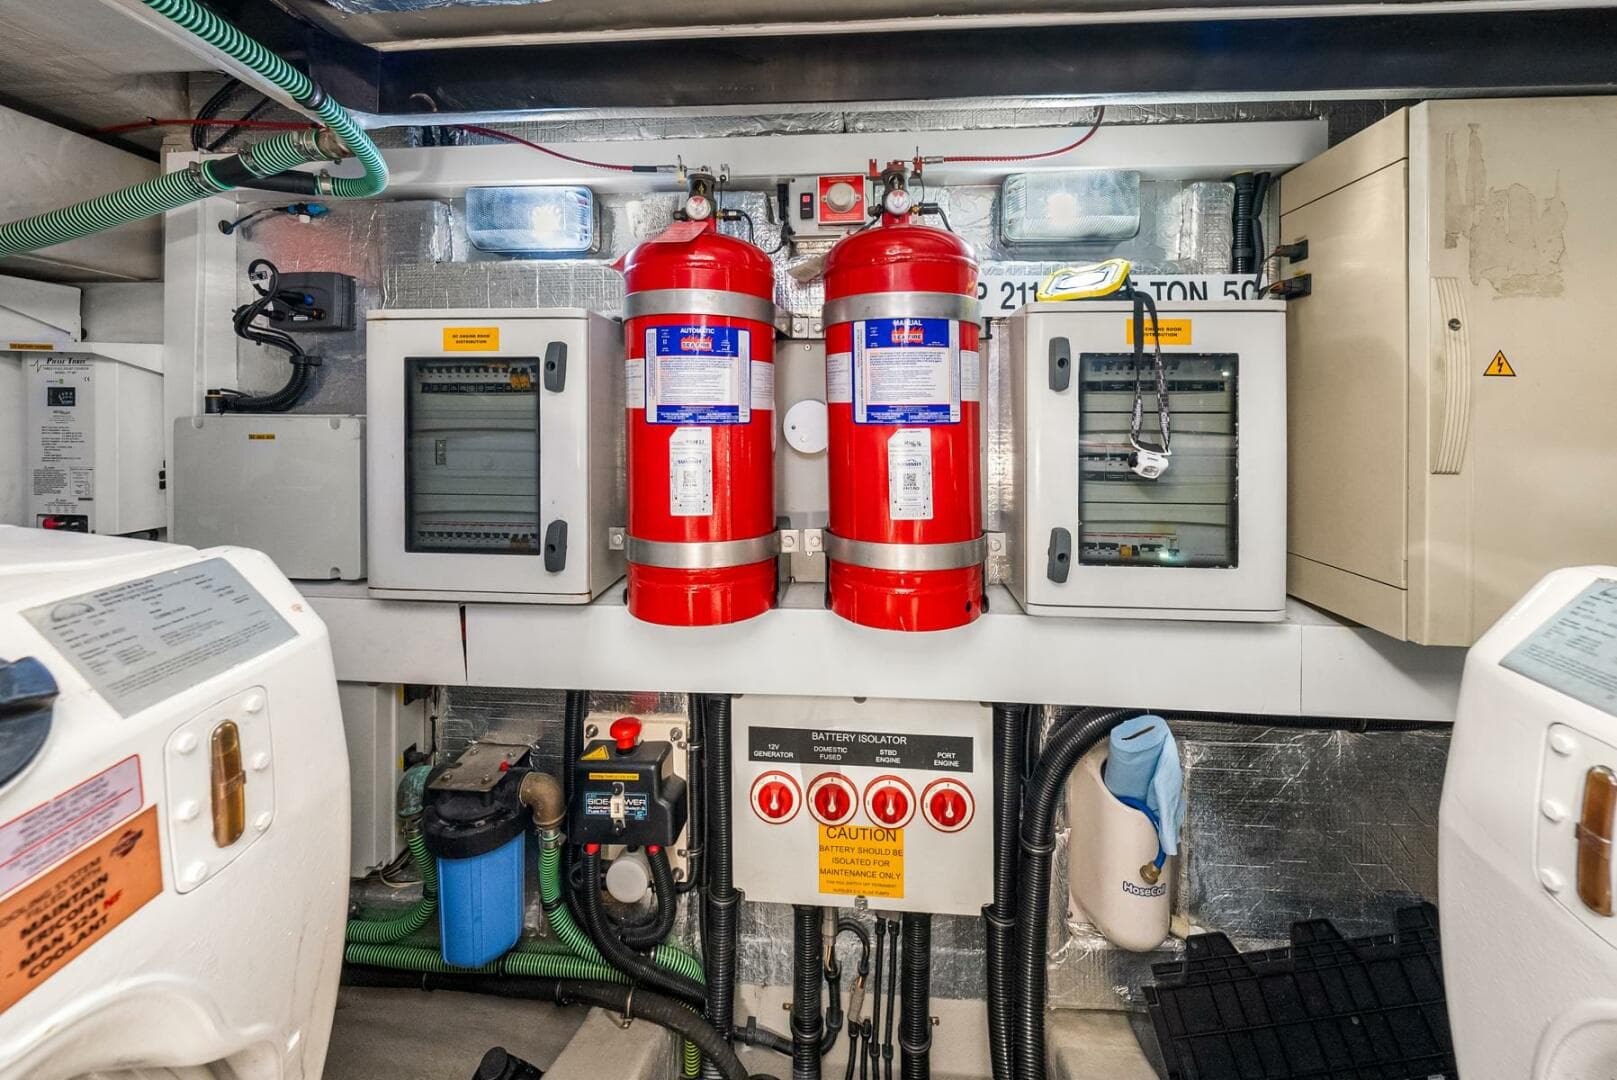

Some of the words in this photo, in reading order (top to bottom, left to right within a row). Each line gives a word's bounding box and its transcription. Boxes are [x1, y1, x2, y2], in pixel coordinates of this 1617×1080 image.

[1150, 280, 1208, 301] TON
[812, 732, 855, 743] BATTERY
[858, 734, 907, 745] ISOLATOR
[753, 750, 794, 758] GENERATOR
[813, 745, 848, 754] DOMESTIC
[937, 751, 956, 759] PORT
[875, 756, 901, 764] ENGINE
[826, 826, 897, 842] CAUTION
[819, 845, 855, 853] BATTERY
[857, 847, 891, 856] SHOULD
[892, 848, 904, 857] BE
[832, 857, 872, 866] ISOLATED
[819, 868, 877, 879] MAINTENANCE
[878, 871, 901, 880] ONLY
[20, 872, 109, 940] MAINTAIN
[26, 888, 106, 950] FRICOFIN
[18, 932, 65, 971] MAN
[69, 908, 98, 935] 324
[27, 913, 109, 979] COOLANT
